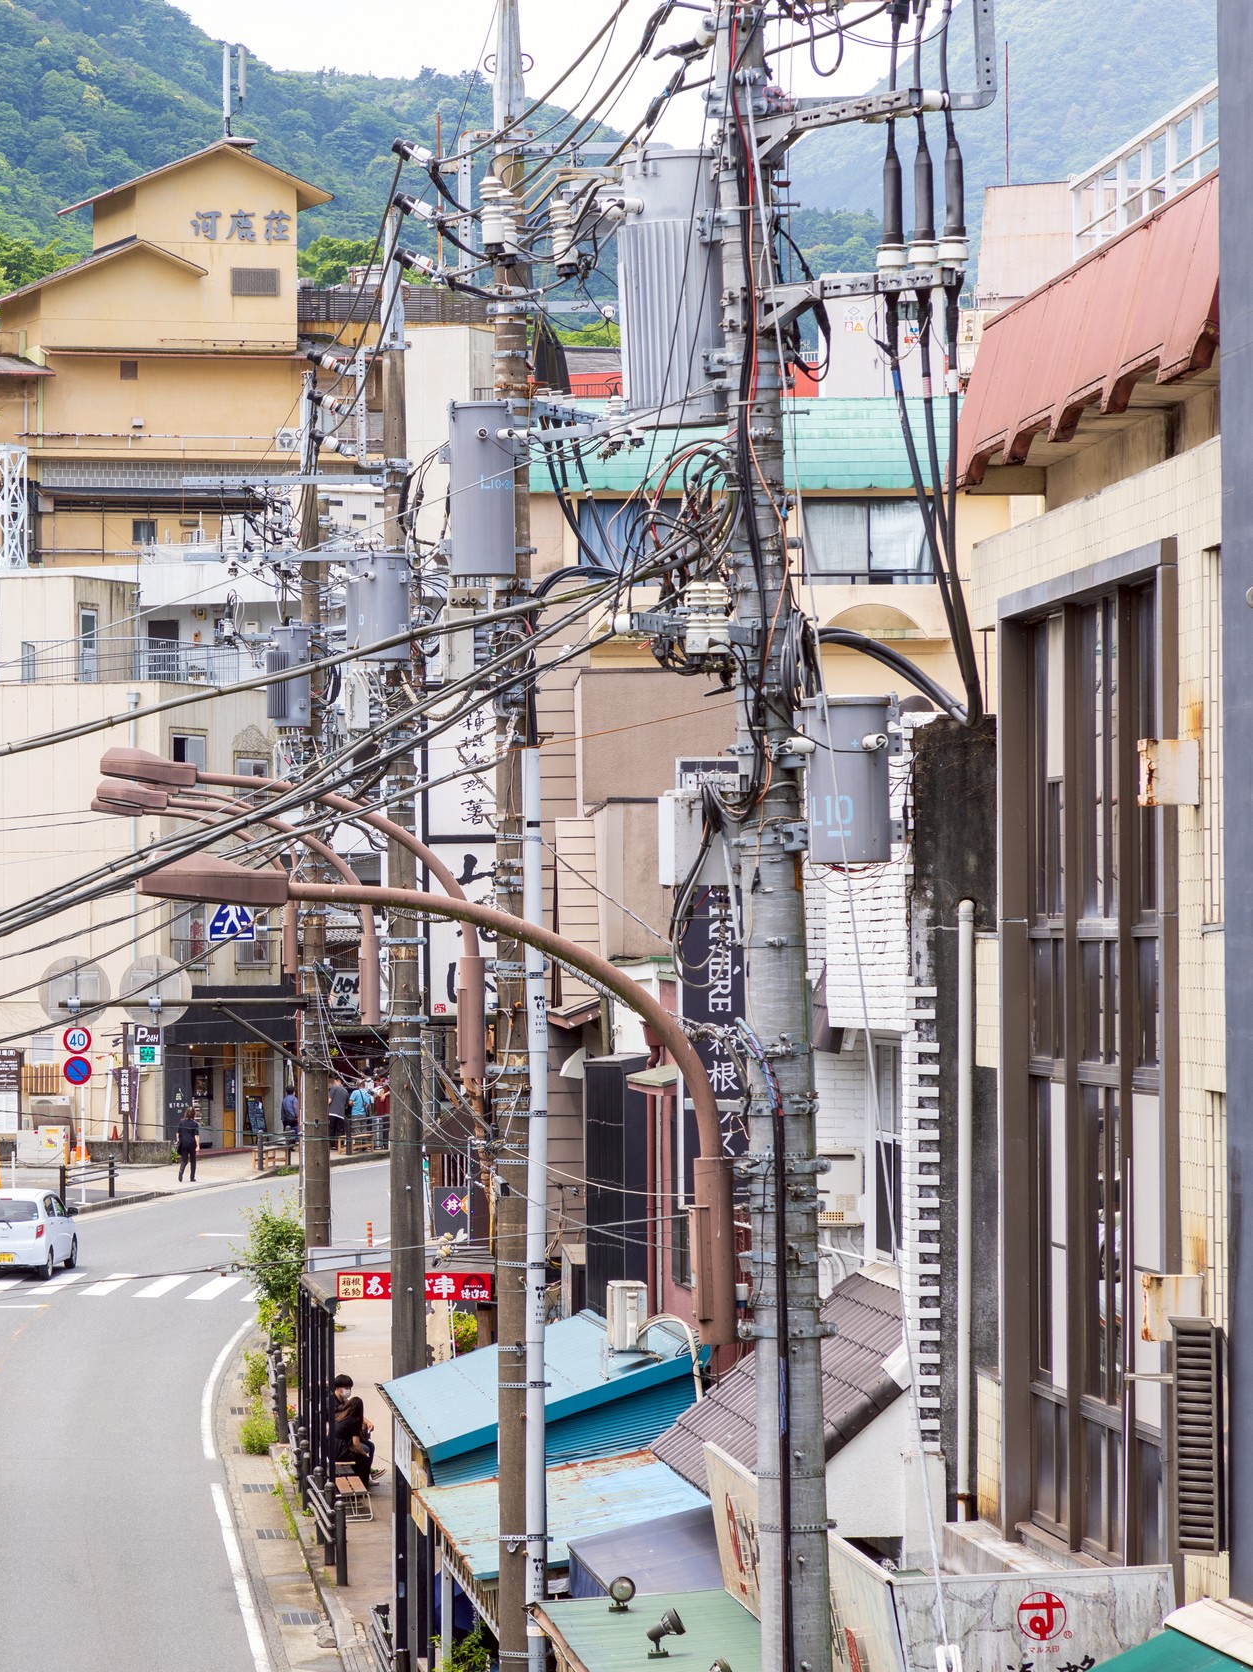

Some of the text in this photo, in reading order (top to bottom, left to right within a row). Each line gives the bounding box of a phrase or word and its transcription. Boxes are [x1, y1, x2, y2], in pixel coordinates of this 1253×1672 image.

[190, 209, 292, 246] 河鹿荘
[69, 1033, 86, 1047] 40
[136, 1027, 159, 1043] P 24H
[341, 1277, 362, 1287] 箱根
[1028, 1645, 1061, 1654] マルス印
